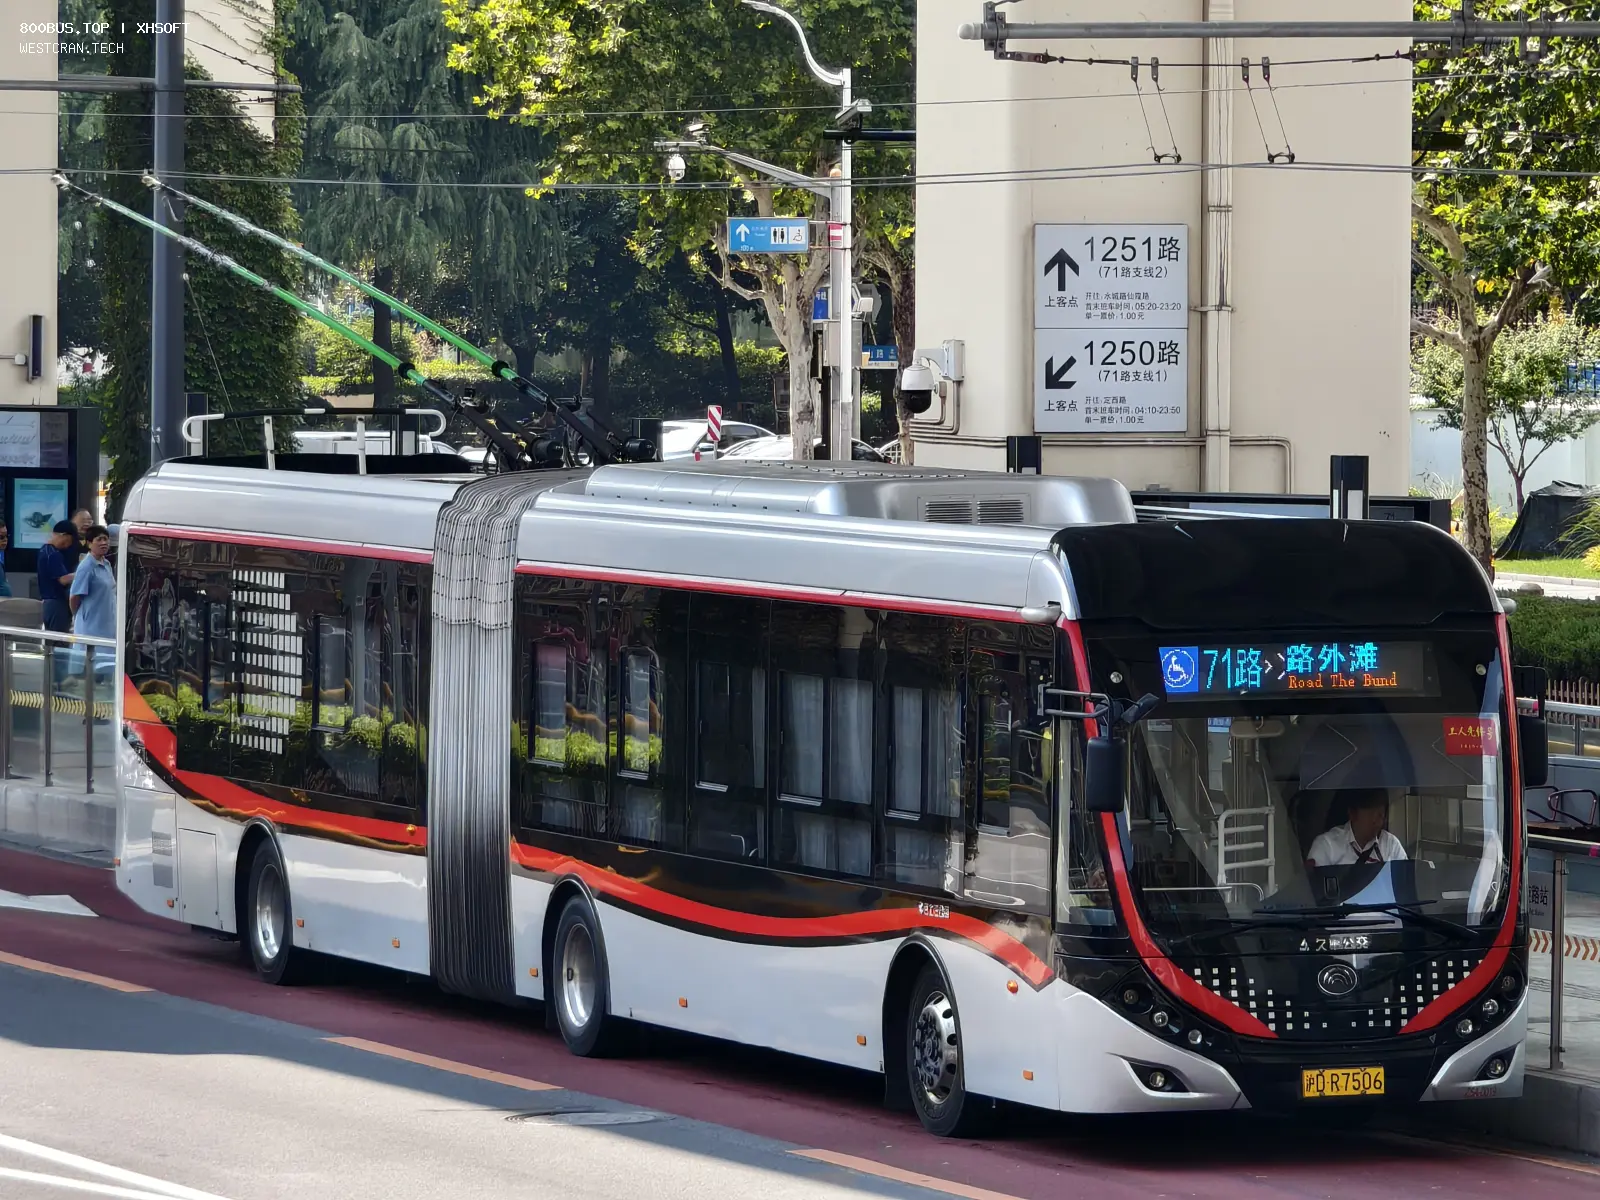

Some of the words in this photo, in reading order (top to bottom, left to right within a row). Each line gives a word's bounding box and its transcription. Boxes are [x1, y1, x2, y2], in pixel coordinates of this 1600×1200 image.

[1084, 236, 1181, 262] 1251路
[1098, 266, 1168, 279] (71路支线2)
[1044, 295, 1079, 308] 上客点
[1084, 340, 1181, 366] 1250路
[1098, 370, 1168, 383] (71路支线1)
[1044, 400, 1078, 412] 上客点
[1203, 648, 1263, 689] 71路
[1286, 642, 1378, 673] 路外滩
[1288, 675, 1323, 689] Road
[1331, 674, 1355, 687] The
[1363, 672, 1398, 687] Bund
